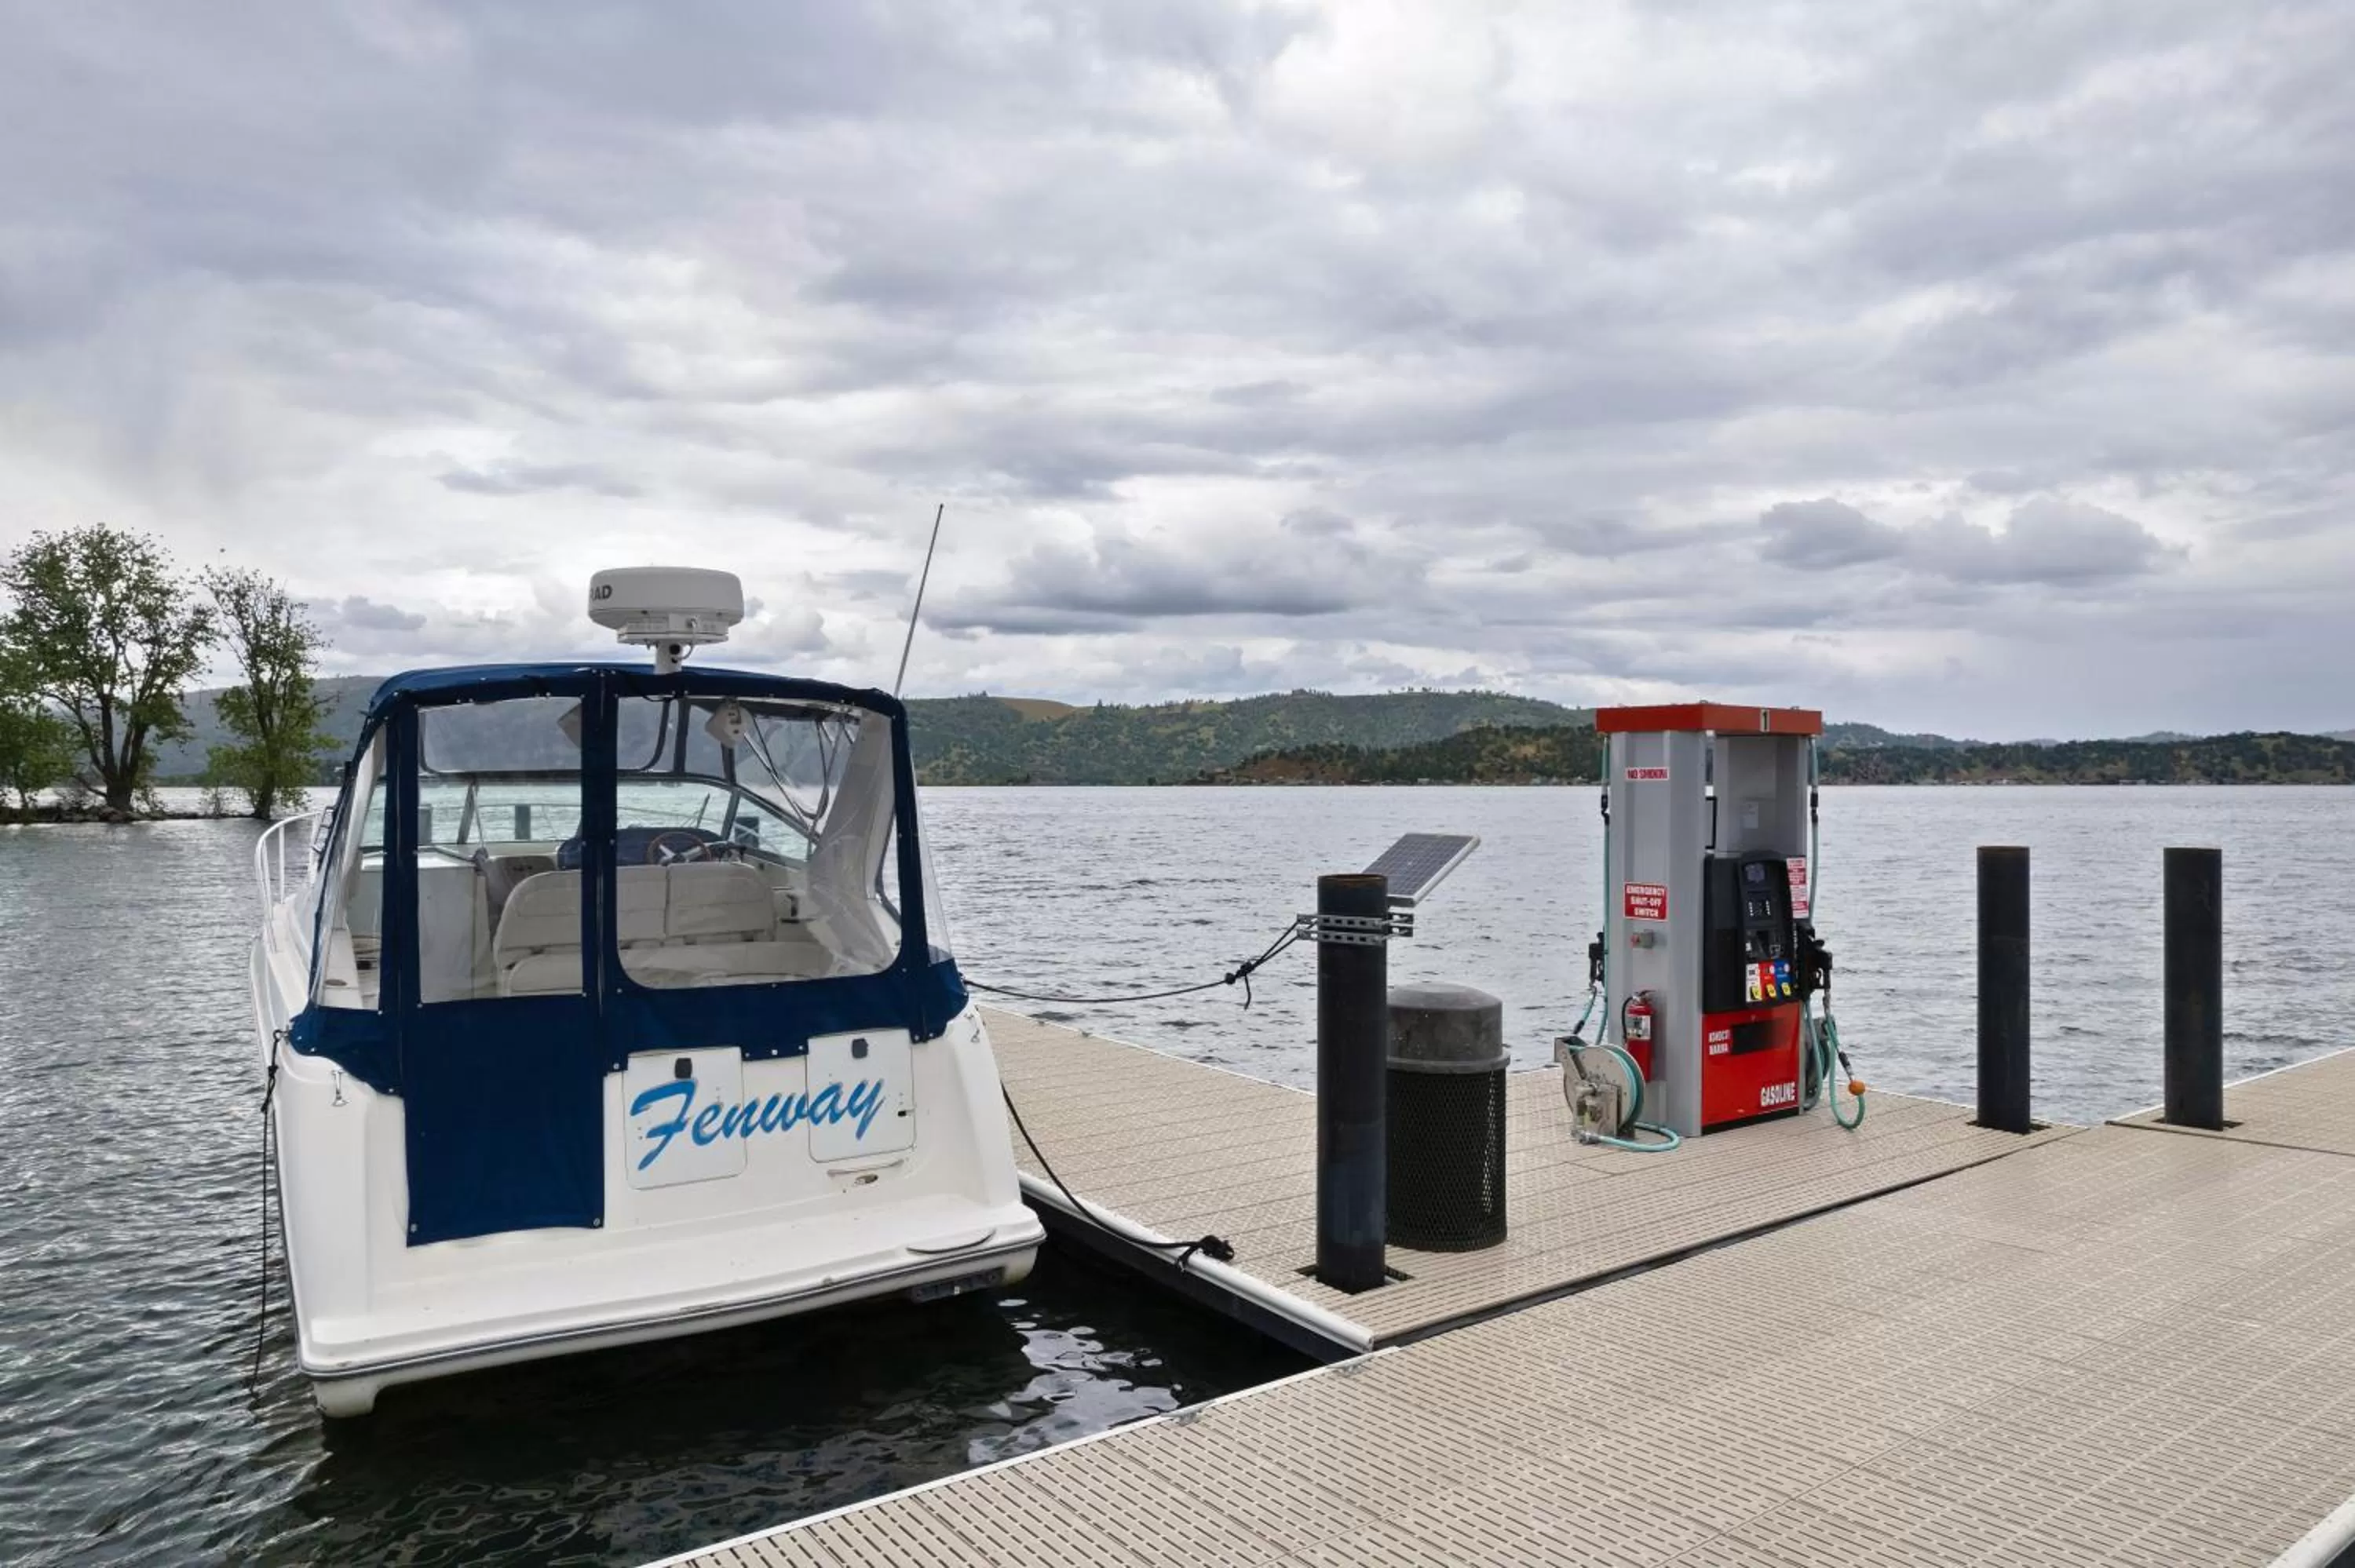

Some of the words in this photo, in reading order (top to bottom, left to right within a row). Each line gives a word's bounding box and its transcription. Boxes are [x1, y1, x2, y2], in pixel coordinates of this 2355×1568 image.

[1627, 769, 1638, 779] NO
[1639, 769, 1667, 779] SMOKING
[1626, 884, 1665, 897] EMERGENCY
[1630, 895, 1663, 907] SHUT-OFF
[1634, 906, 1659, 917] SWITCH
[1761, 1081, 1795, 1107] GASOLINE
[630, 1078, 885, 1171] Fenway
